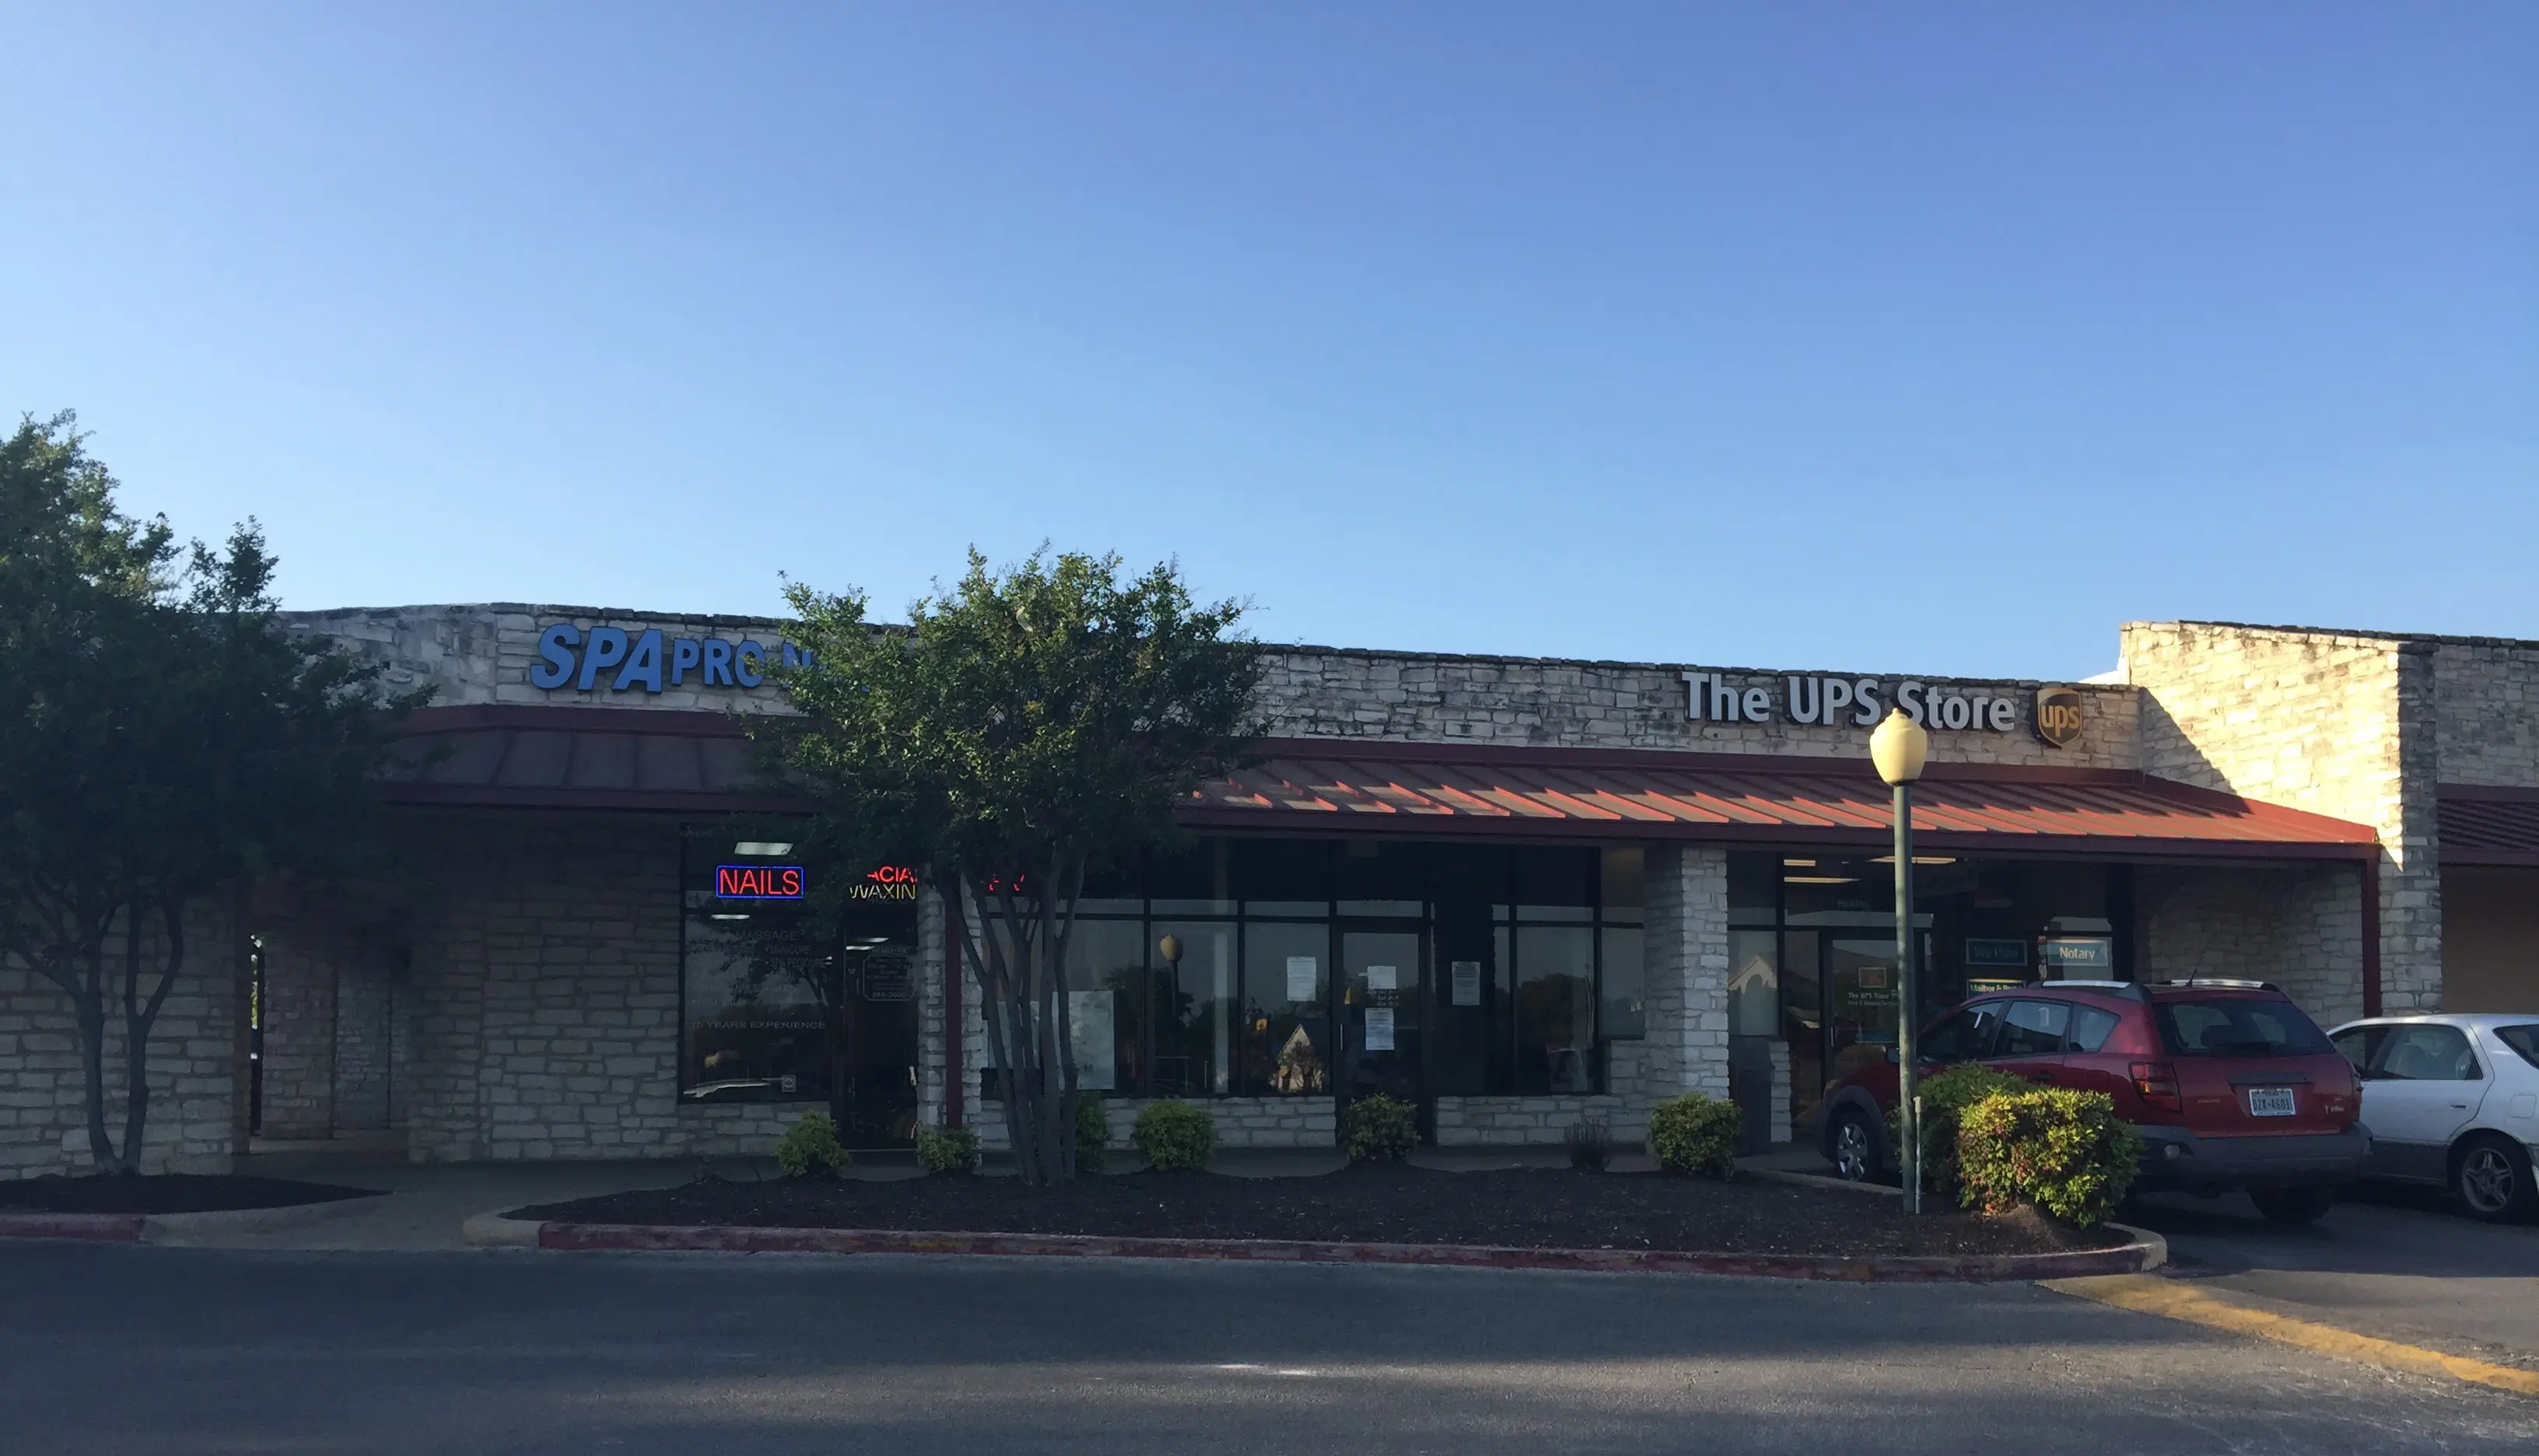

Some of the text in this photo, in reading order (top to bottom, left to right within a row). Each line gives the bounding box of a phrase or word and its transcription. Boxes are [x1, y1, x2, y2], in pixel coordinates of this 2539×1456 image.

[530, 624, 663, 693] SPA
[671, 638, 765, 688] PRO
[1681, 670, 2015, 731] The UPS Store
[2040, 703, 2080, 738] ups
[719, 869, 800, 895] NAILS
[849, 884, 917, 901] WAXIN
[2059, 946, 2095, 962] Notary
[706, 1020, 747, 1029] YEARS
[750, 1020, 826, 1029] EXPERIENCE
